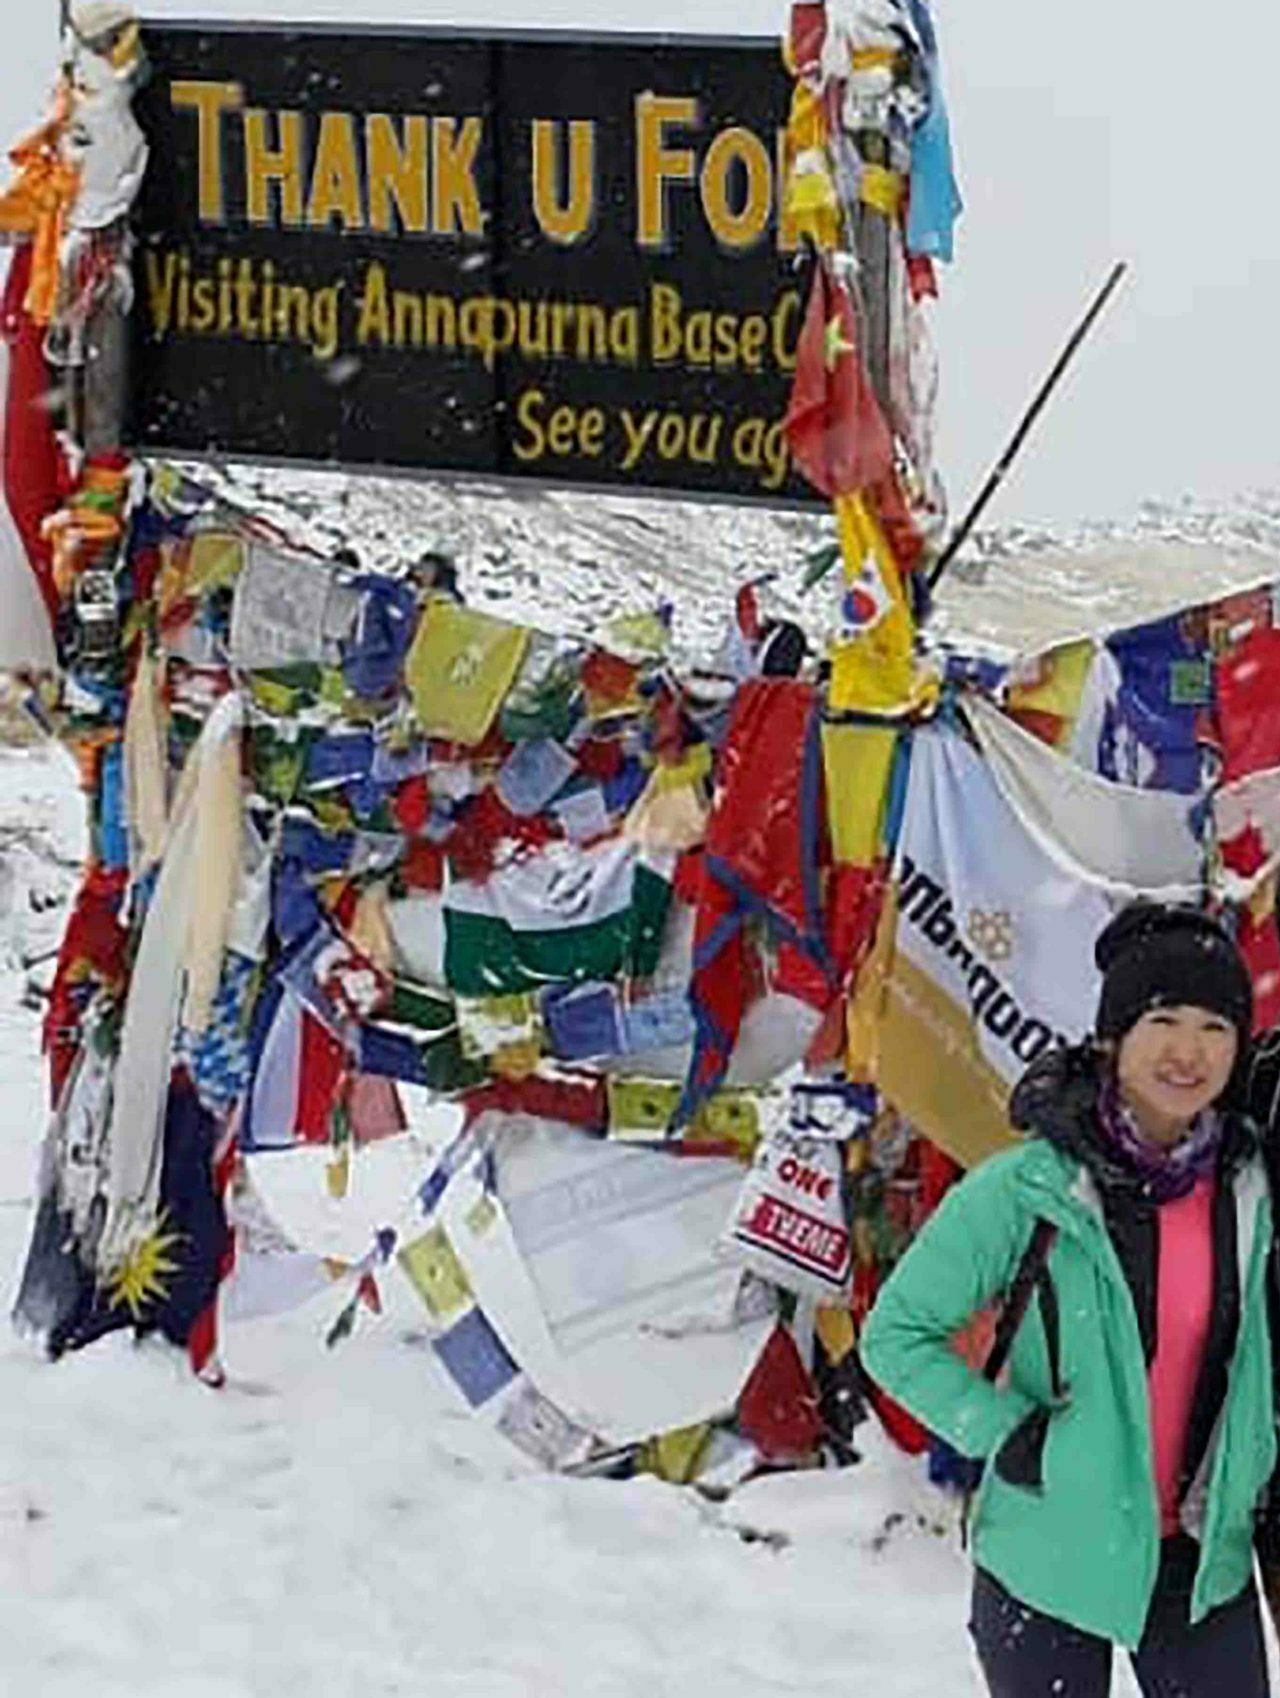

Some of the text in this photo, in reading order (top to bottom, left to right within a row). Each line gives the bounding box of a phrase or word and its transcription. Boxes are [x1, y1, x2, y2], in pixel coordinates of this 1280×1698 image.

[170, 79, 483, 235] THANK
[147, 250, 345, 360] Visiting
[356, 258, 640, 373] Annapurna
[511, 388, 789, 489] See you ag
